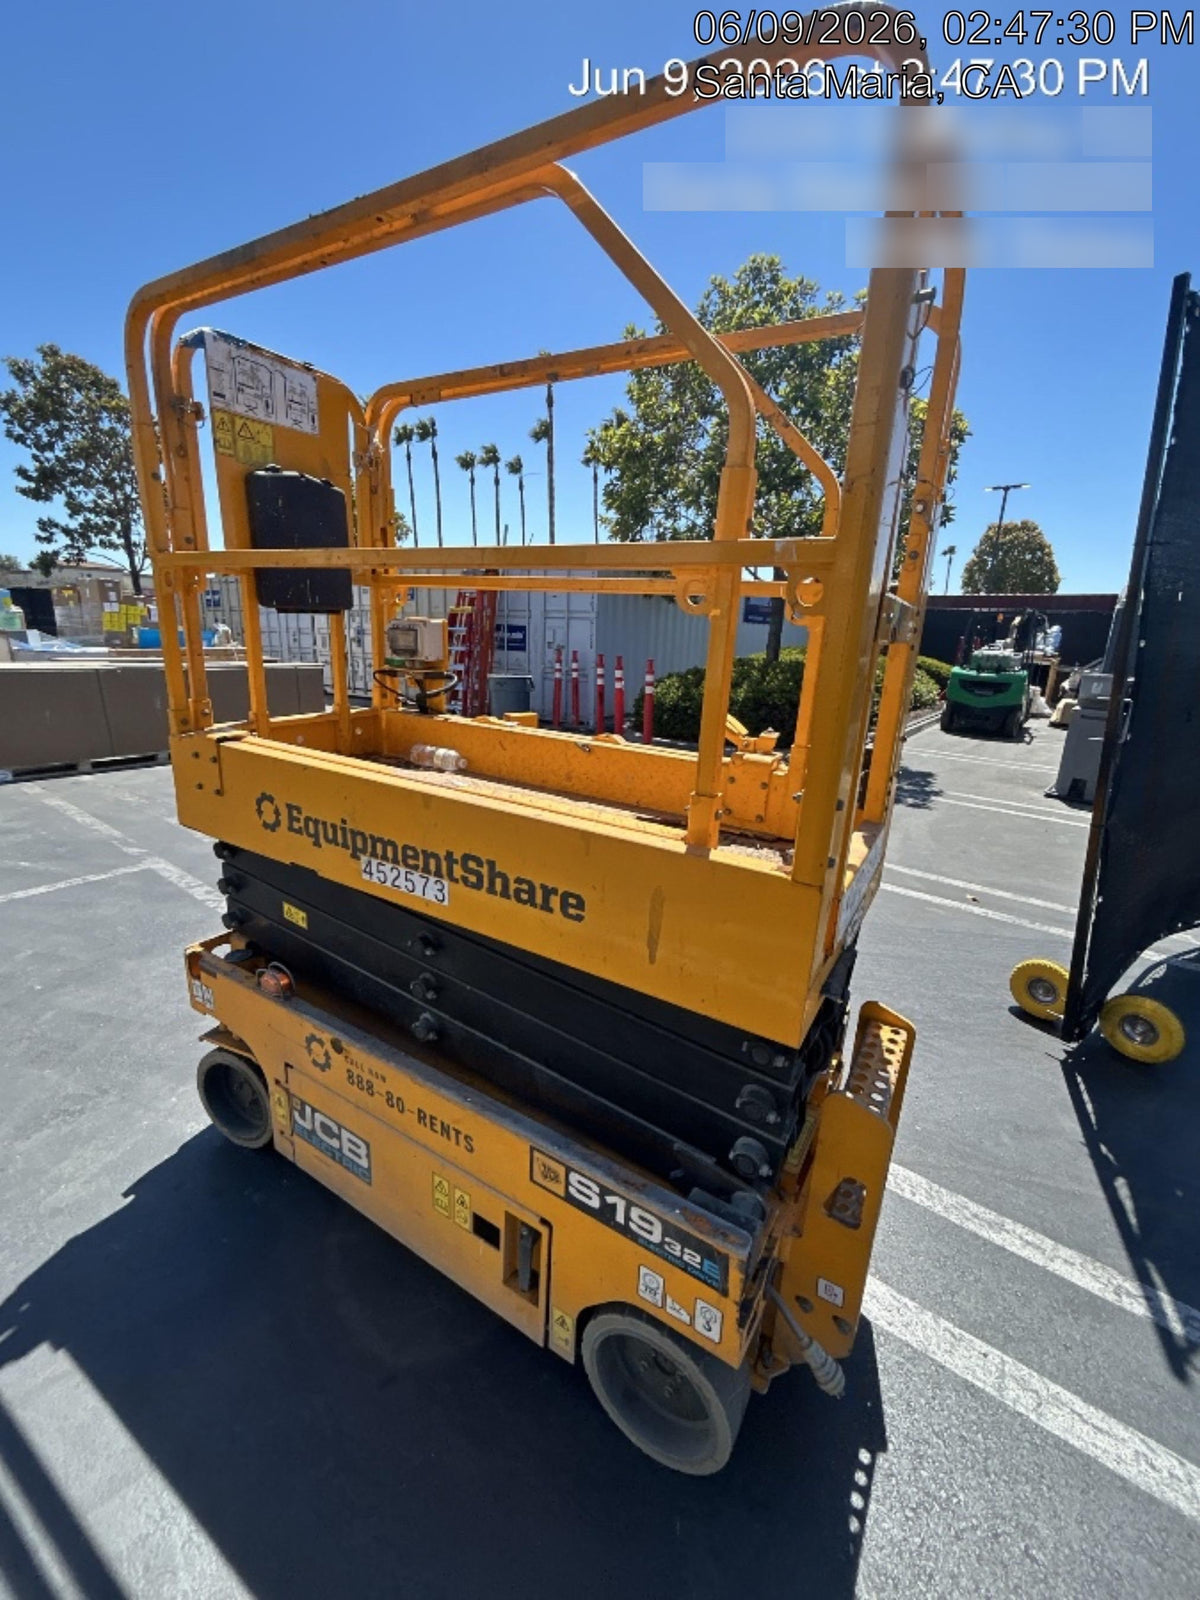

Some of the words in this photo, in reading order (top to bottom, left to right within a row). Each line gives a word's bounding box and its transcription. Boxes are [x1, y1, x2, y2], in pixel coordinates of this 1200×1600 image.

[285, 802, 586, 923] EquipmentShare
[362, 859, 446, 904] 452573
[293, 1103, 369, 1169] JCB
[346, 1068, 475, 1154] 888-80-RENTS
